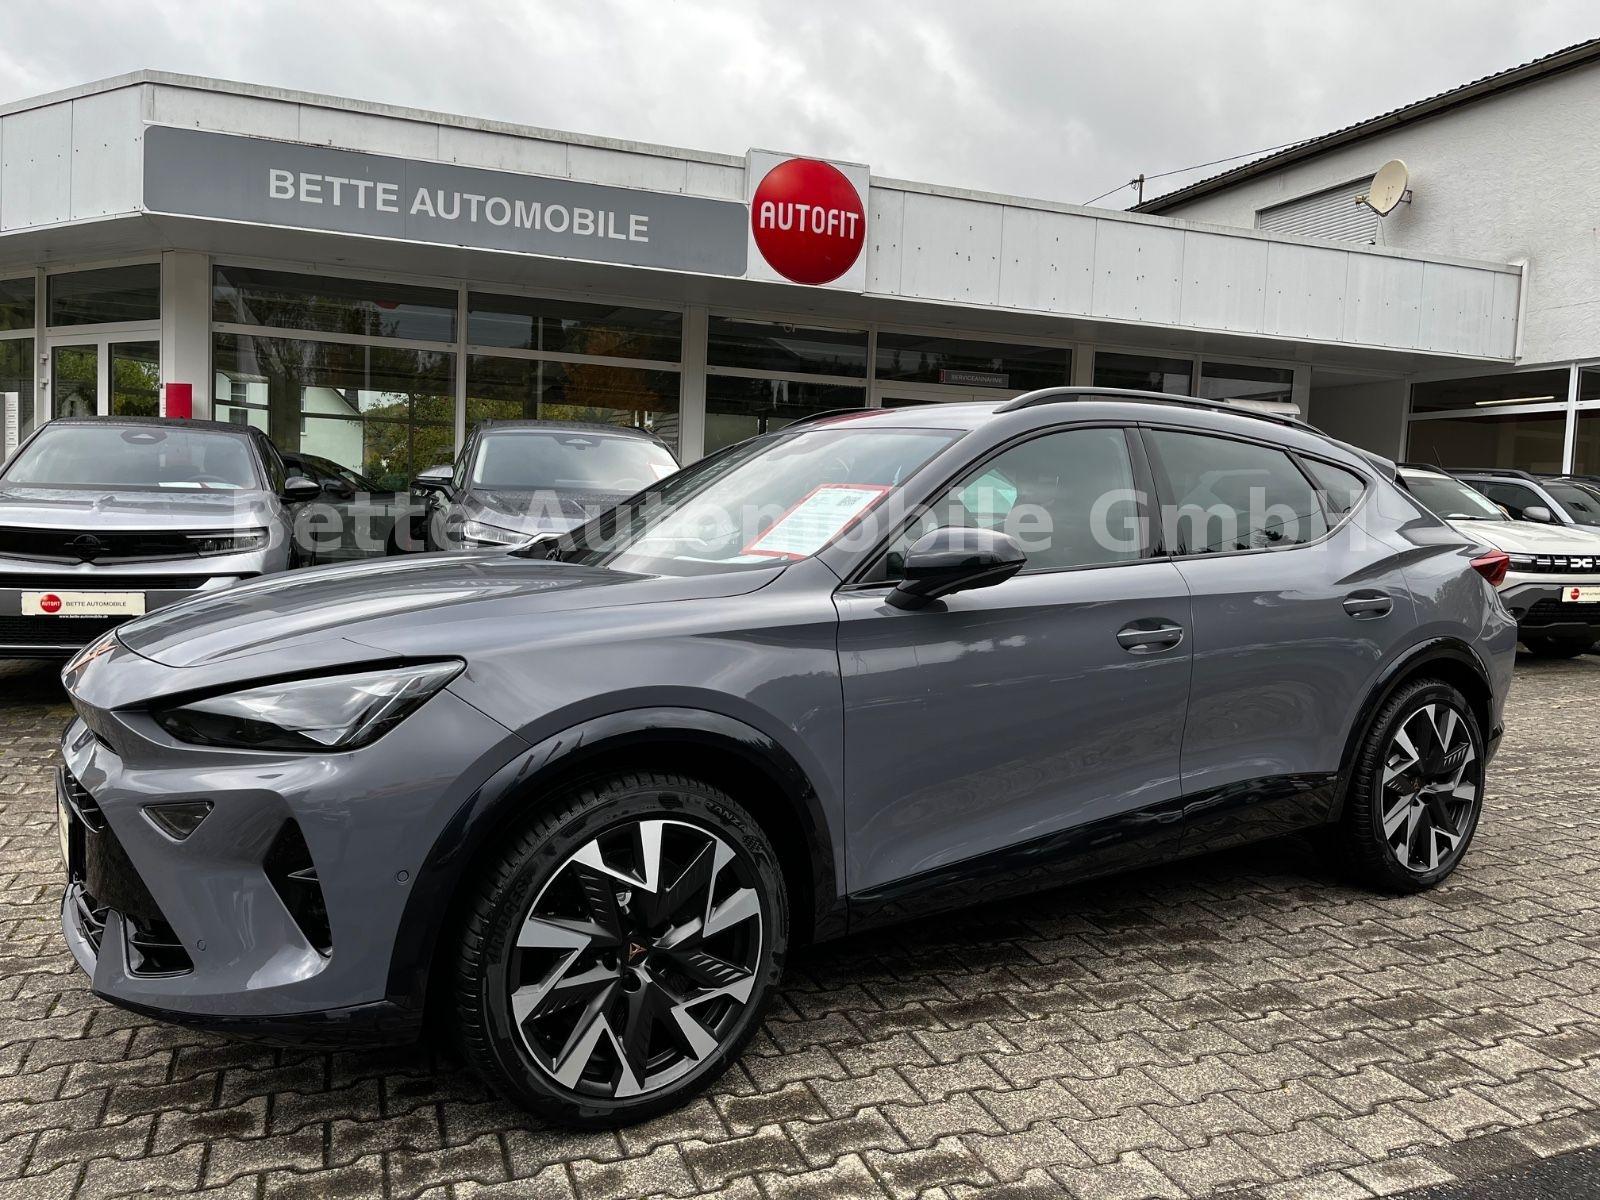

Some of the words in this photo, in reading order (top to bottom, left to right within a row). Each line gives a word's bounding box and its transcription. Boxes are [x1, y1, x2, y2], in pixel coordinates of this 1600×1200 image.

[268, 168, 400, 213] BETTE
[410, 187, 650, 243] AUTOMOBILE
[759, 200, 860, 240] AUTOFIT
